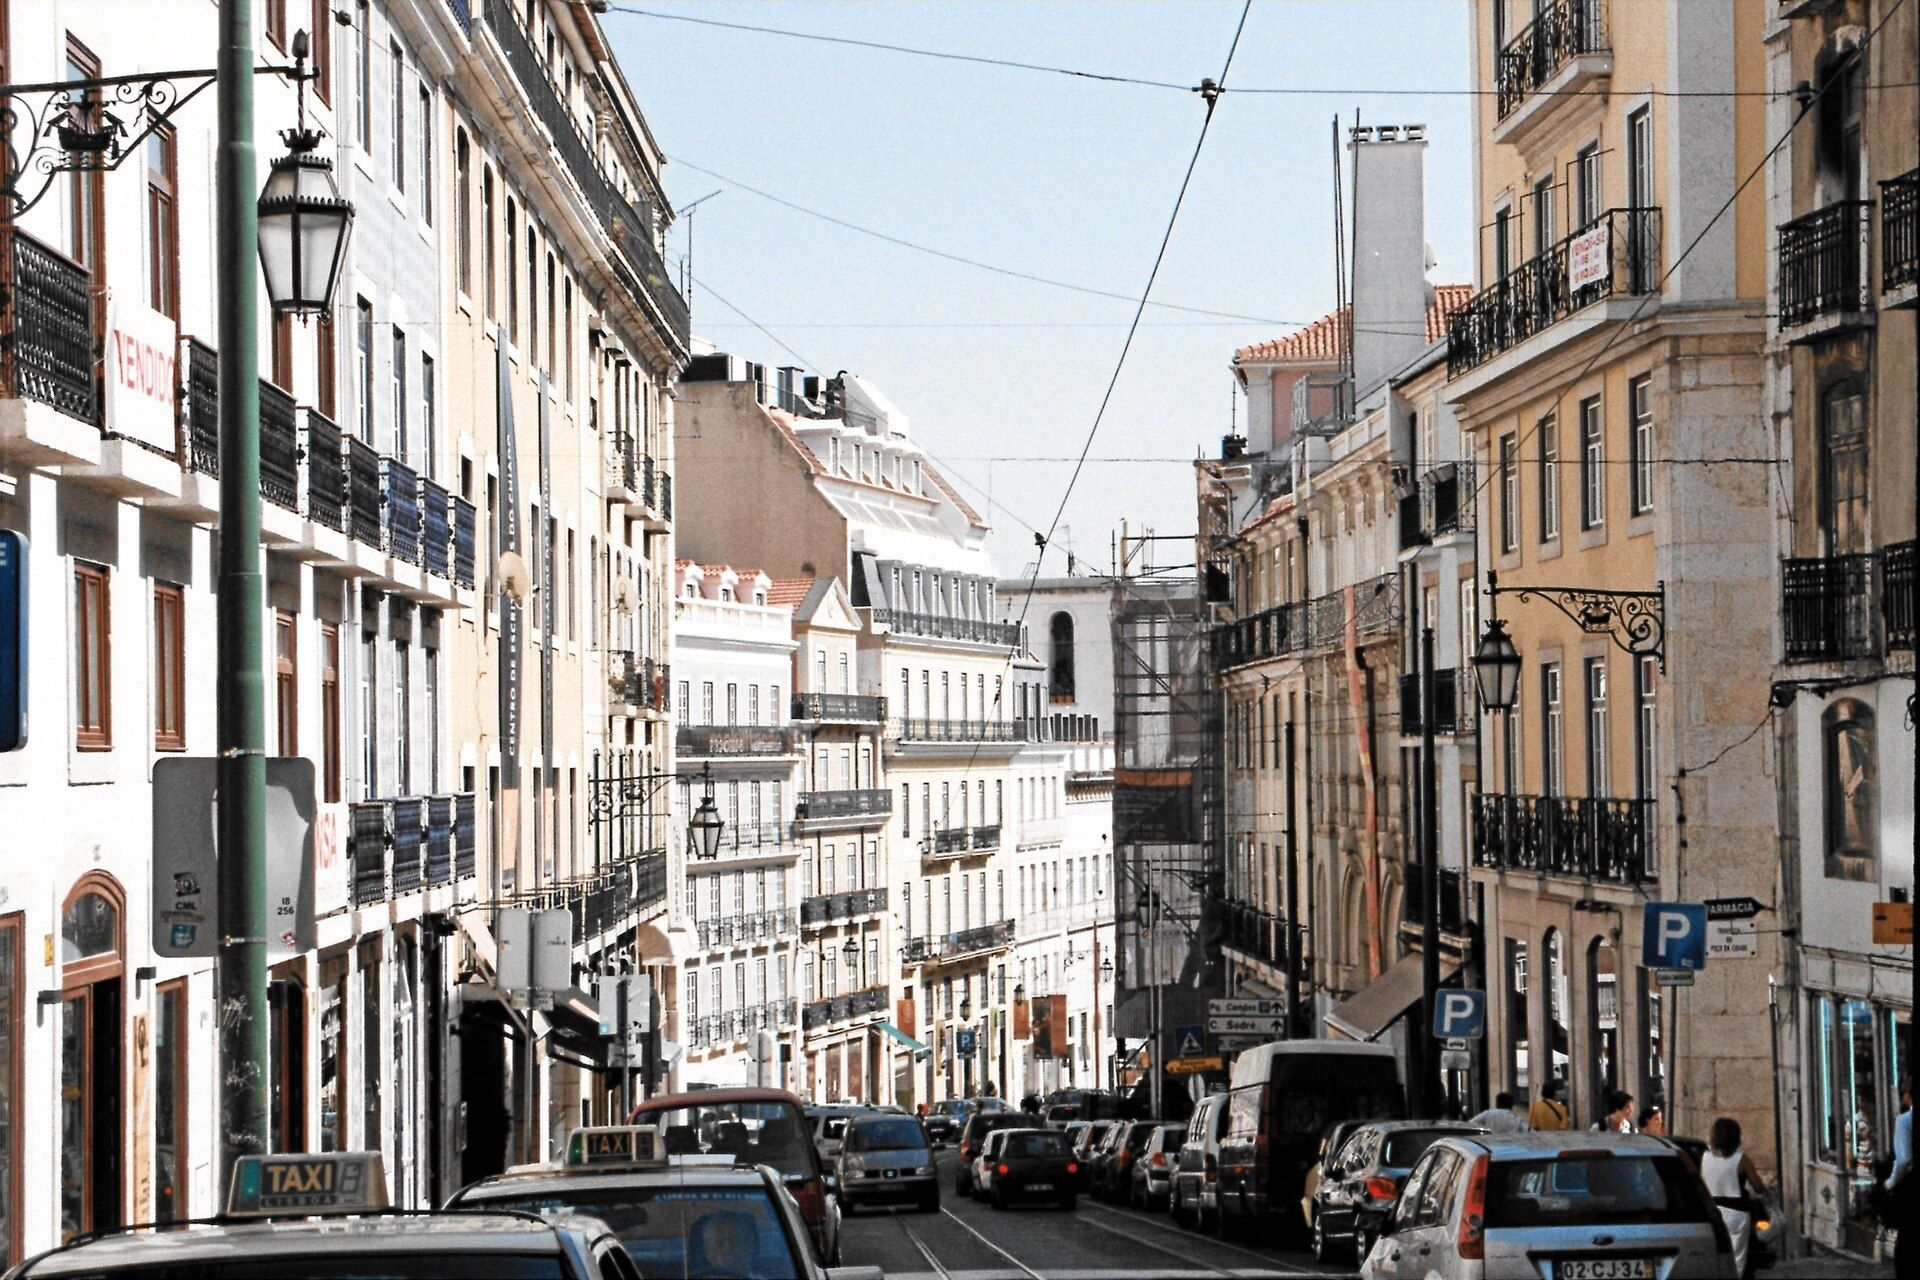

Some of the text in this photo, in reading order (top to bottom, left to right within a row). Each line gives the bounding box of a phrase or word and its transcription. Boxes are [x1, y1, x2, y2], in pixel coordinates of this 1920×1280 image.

[505, 434, 514, 503] CHIADO
[508, 509, 515, 535] DO
[509, 659, 516, 681] DE
[175, 902, 197, 910] CML
[277, 906, 295, 916] 256
[1657, 911, 1691, 957] P
[1227, 1019, 1256, 1030] Sodré
[1442, 994, 1474, 1033] P
[592, 1133, 632, 1154] TAXI
[267, 1163, 332, 1193] TAXI
